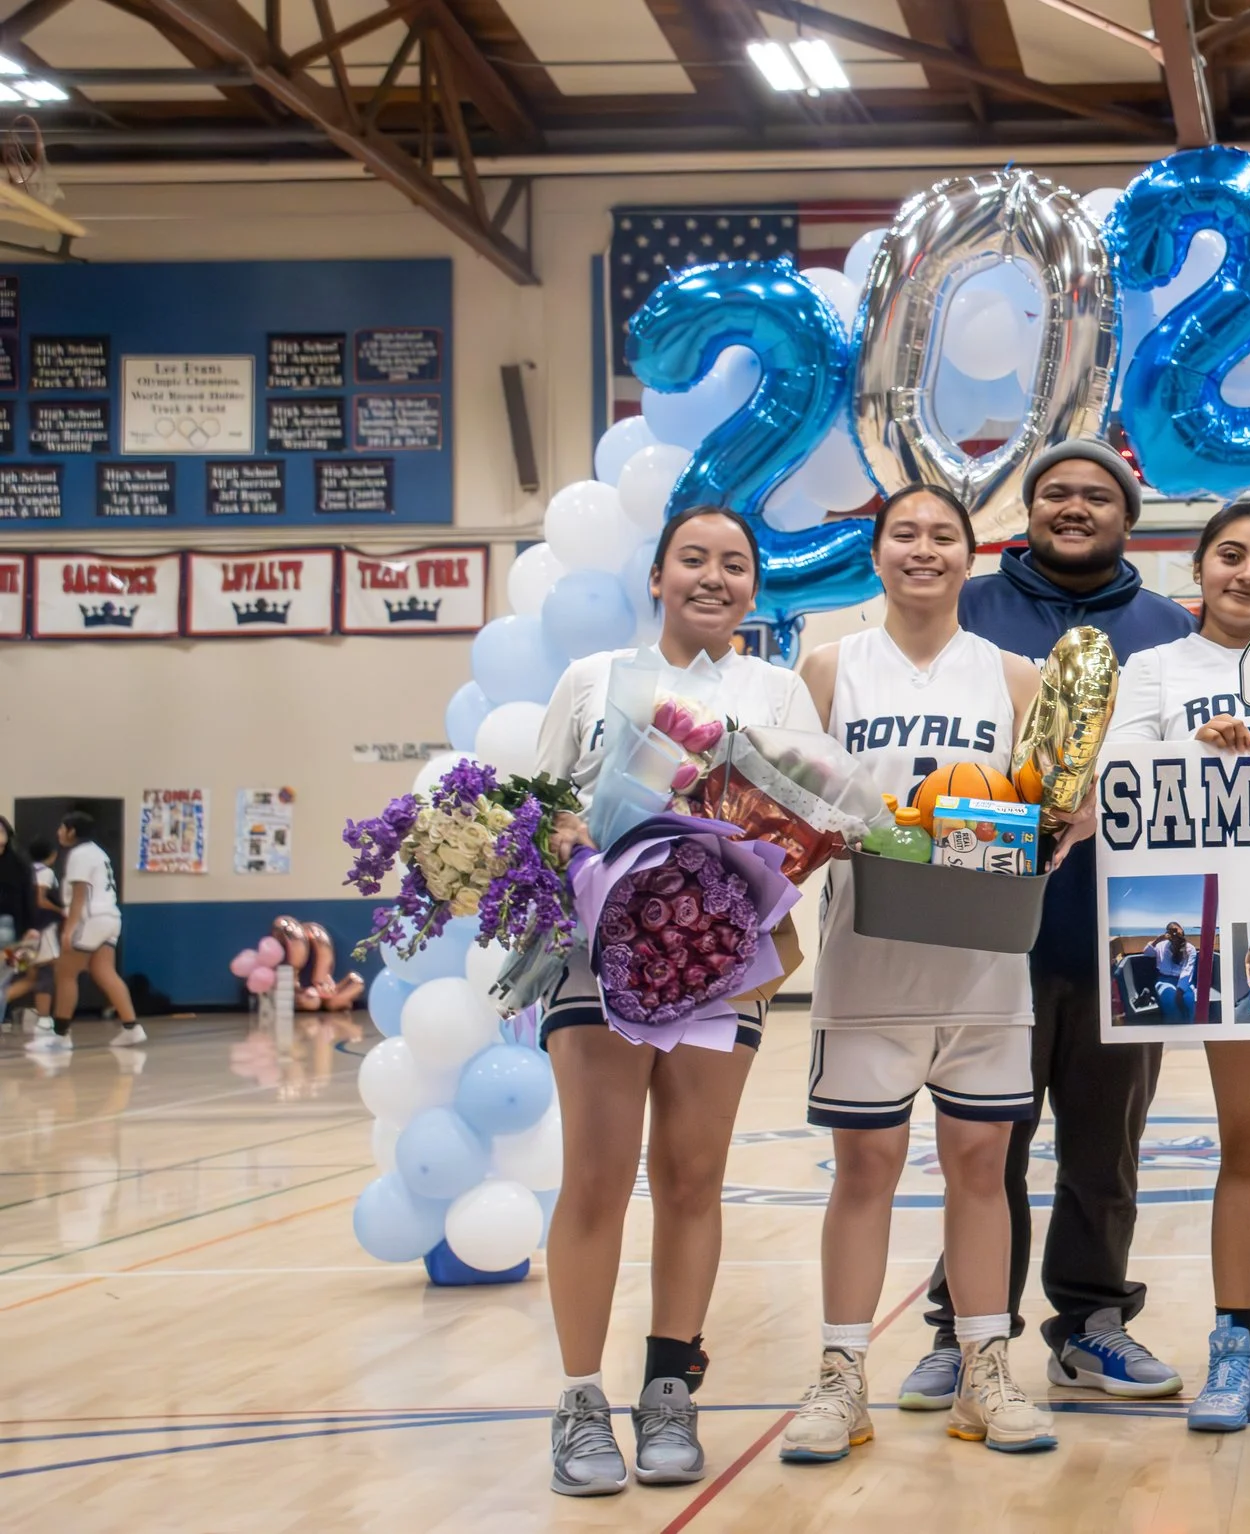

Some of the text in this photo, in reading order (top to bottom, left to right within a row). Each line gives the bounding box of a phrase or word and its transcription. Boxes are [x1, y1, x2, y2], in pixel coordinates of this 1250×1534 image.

[221, 560, 304, 593] LOYALTY
[415, 558, 469, 589] WORK
[846, 714, 998, 755] ROYALS
[961, 832, 969, 848] REAL
